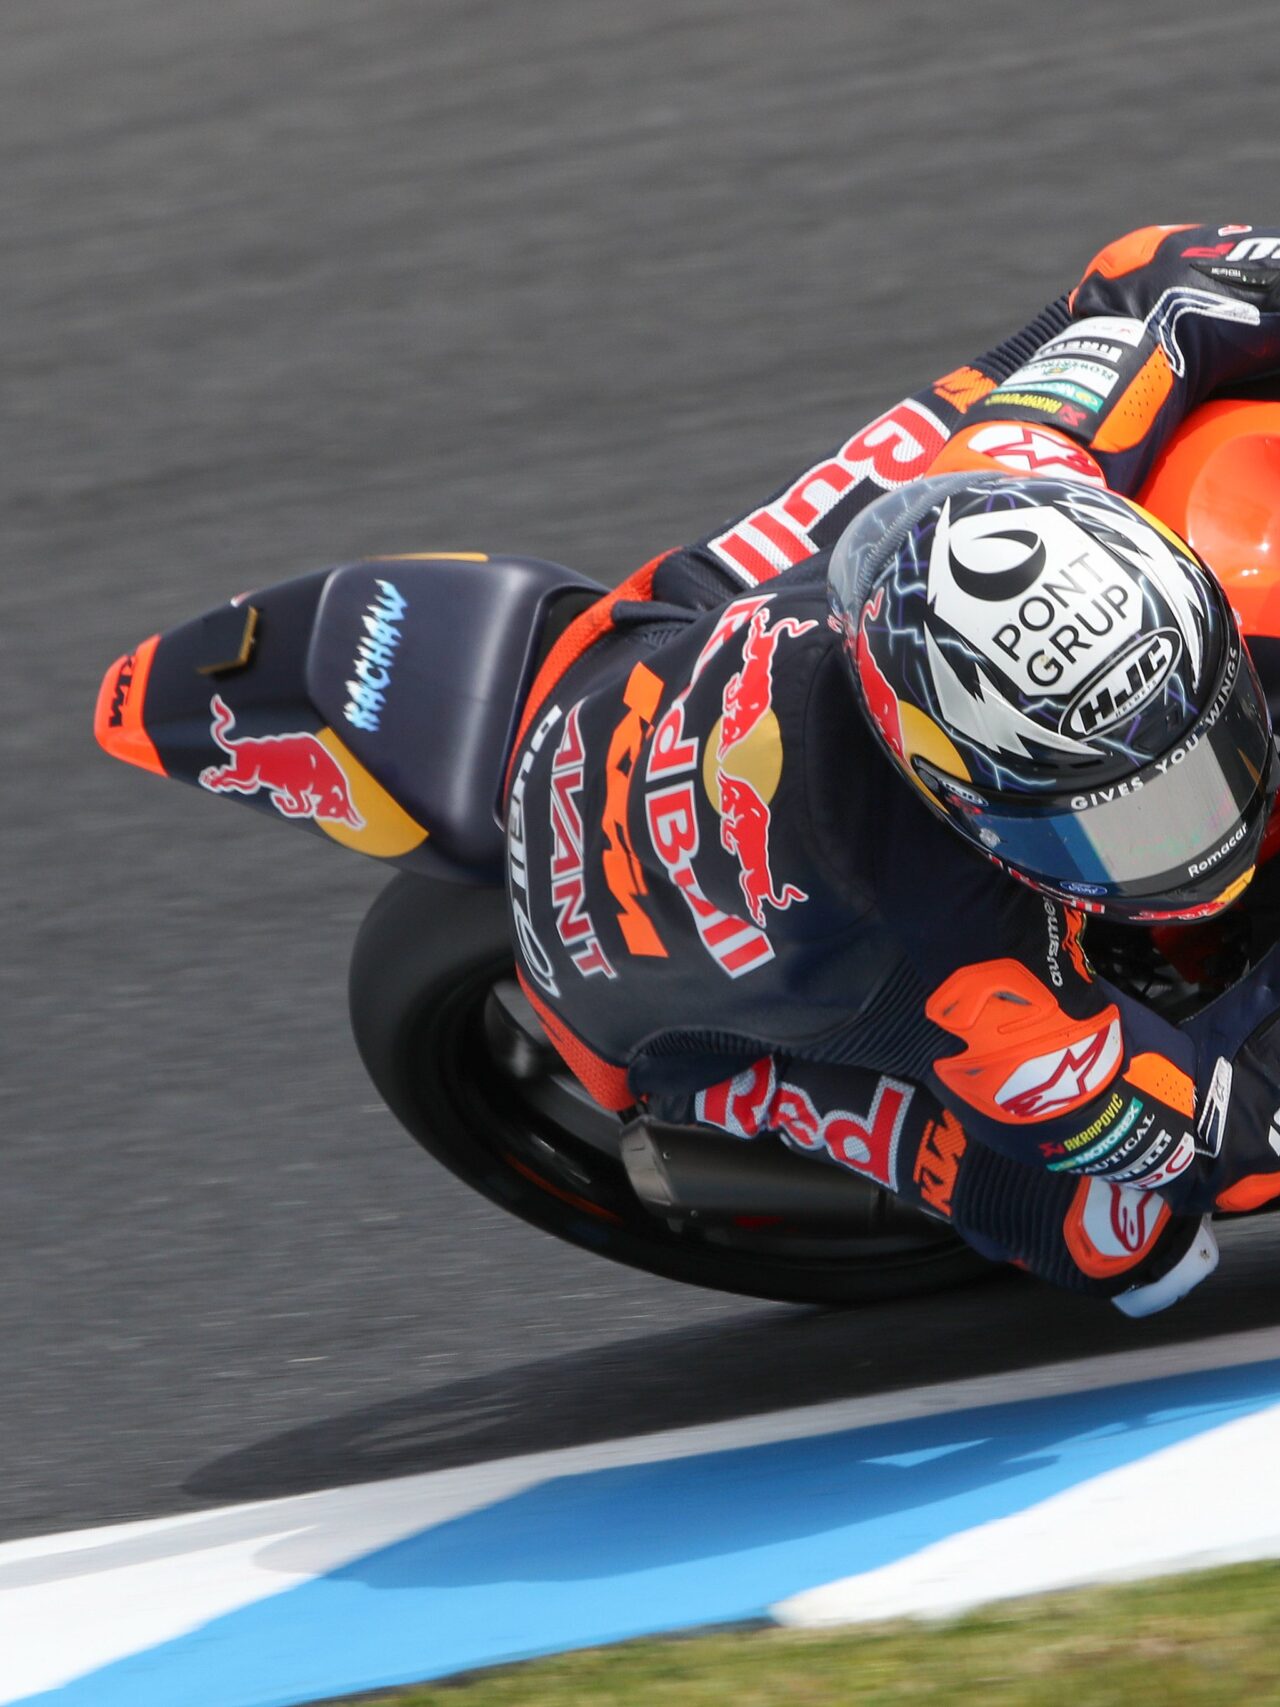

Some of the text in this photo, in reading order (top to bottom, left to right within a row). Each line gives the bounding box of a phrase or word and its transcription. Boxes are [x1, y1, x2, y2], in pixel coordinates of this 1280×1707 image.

[708, 398, 950, 588] Bull
[992, 552, 1104, 662] PONT
[1027, 584, 1128, 687] GRUP
[1070, 647, 1238, 810] GIVES YOU WINGS
[1078, 636, 1168, 733] HJC
[549, 696, 618, 980] AVANT
[1188, 822, 1247, 878] Romacar
[695, 1055, 915, 1194] Red
